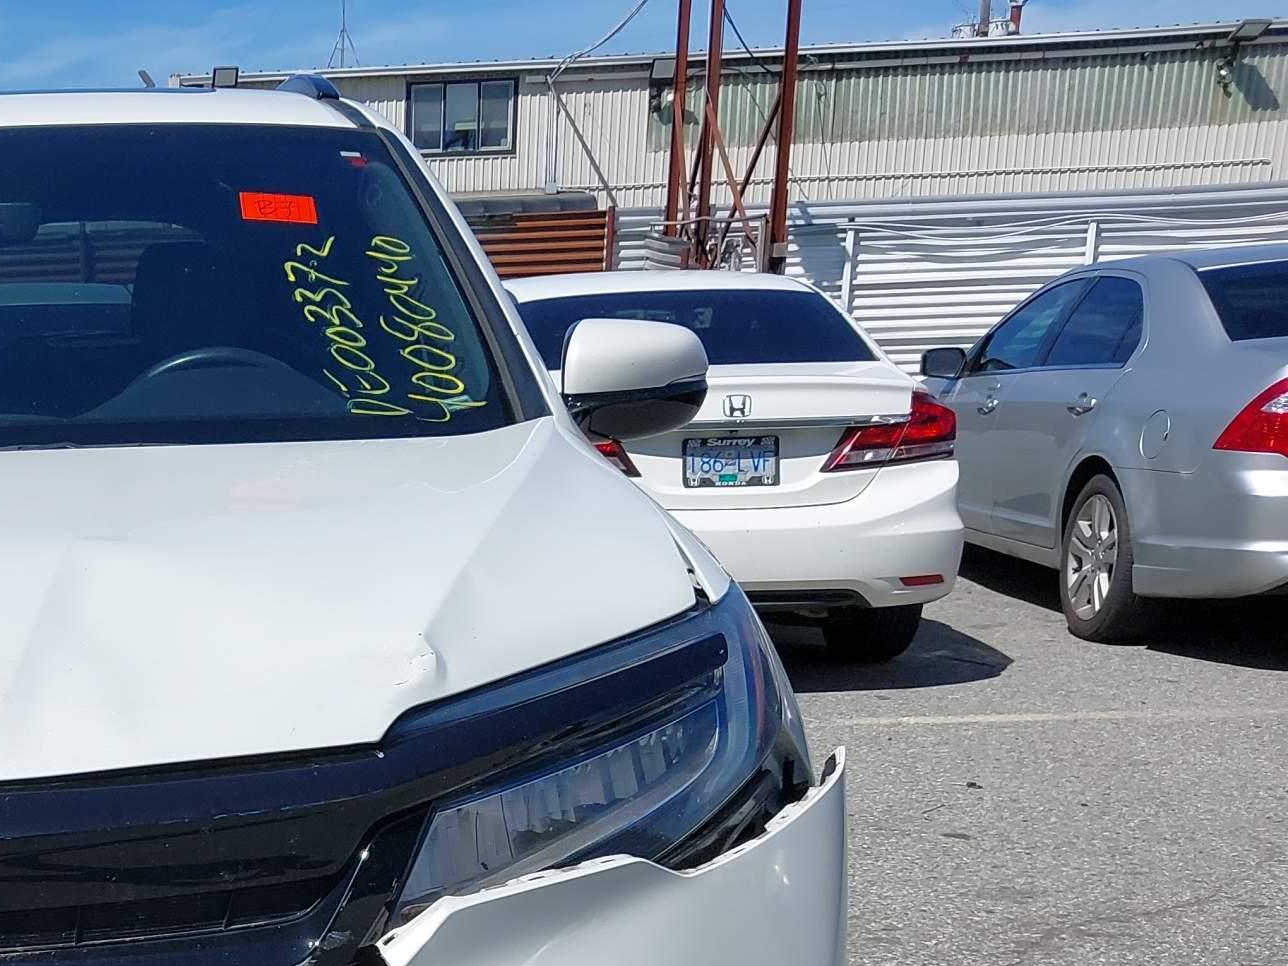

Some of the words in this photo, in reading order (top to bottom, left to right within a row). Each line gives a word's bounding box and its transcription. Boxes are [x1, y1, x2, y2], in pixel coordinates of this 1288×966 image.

[364, 235, 488, 423] 40080440
[706, 438, 756, 448] Surrey
[689, 449, 724, 473] 186
